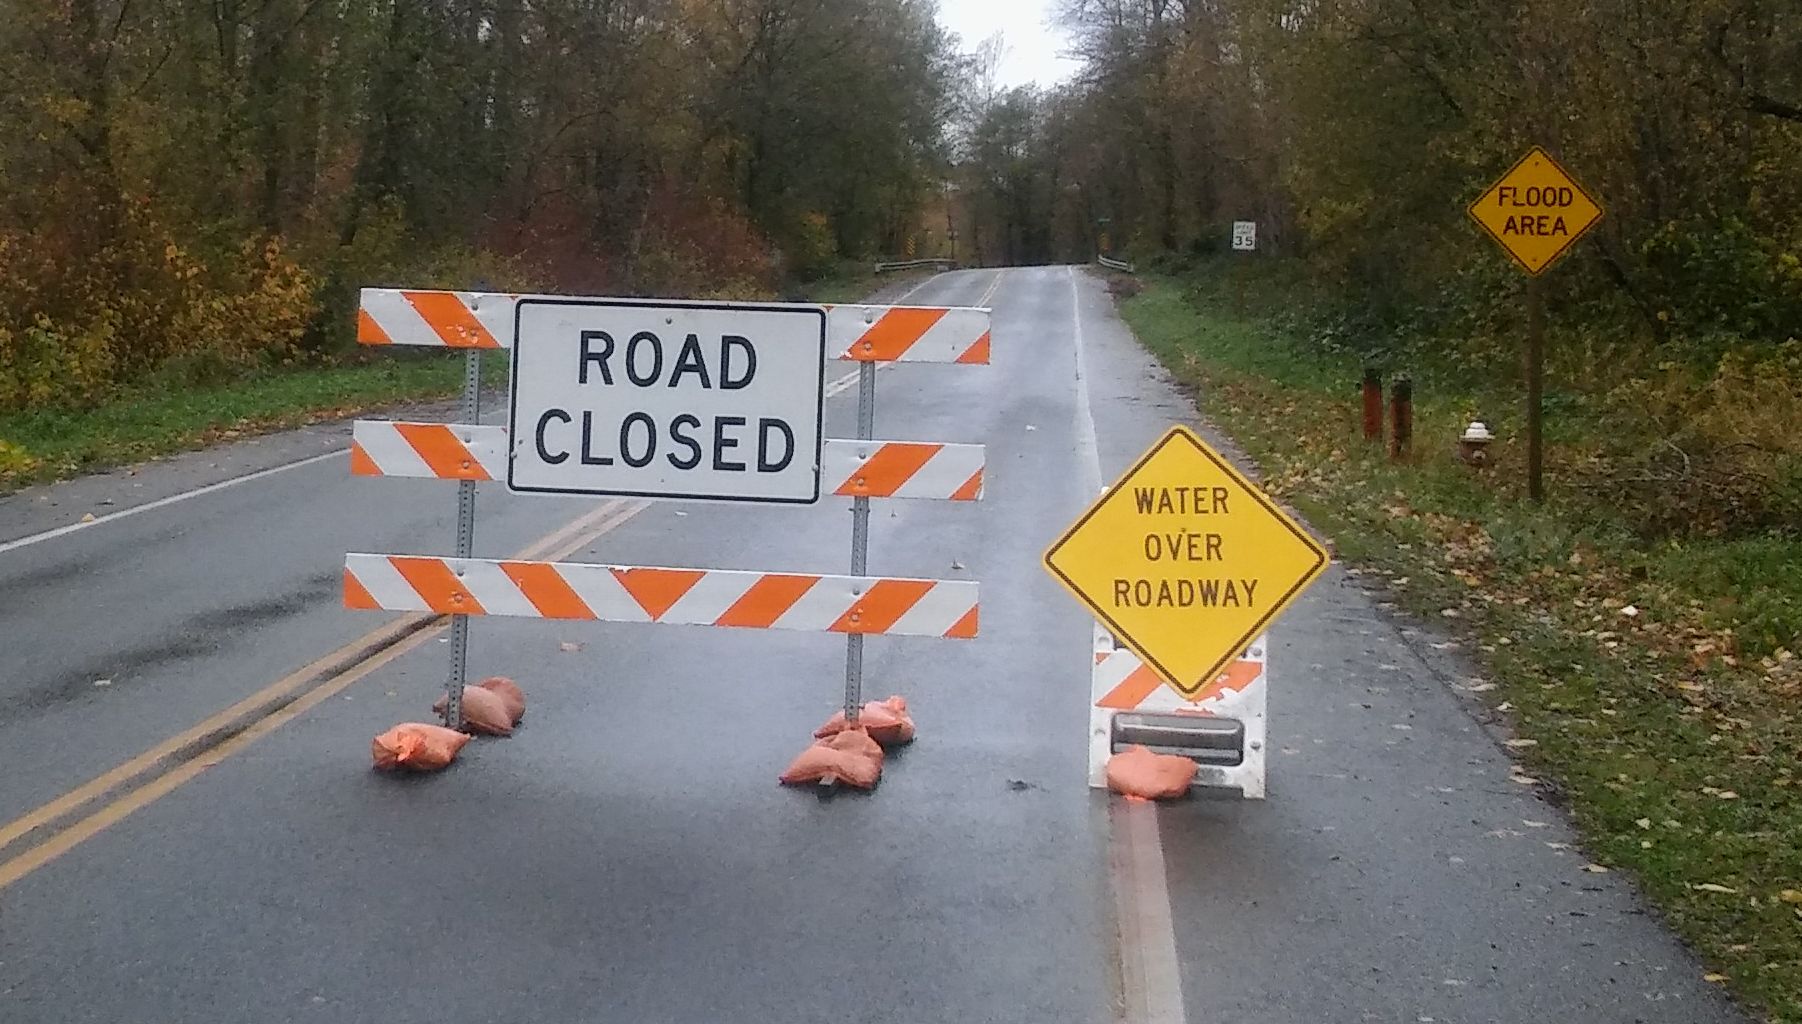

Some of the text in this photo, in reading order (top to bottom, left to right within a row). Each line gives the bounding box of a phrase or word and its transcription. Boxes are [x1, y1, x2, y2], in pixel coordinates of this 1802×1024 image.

[1498, 186, 1574, 207] FLOOD
[1503, 215, 1568, 236] AREA
[1235, 235, 1253, 246] 35
[578, 330, 757, 390] ROAD
[535, 408, 796, 473] CLOSED
[1134, 487, 1229, 515] WATER
[1145, 534, 1223, 561] OVER
[1114, 579, 1259, 607] ROADWAY
